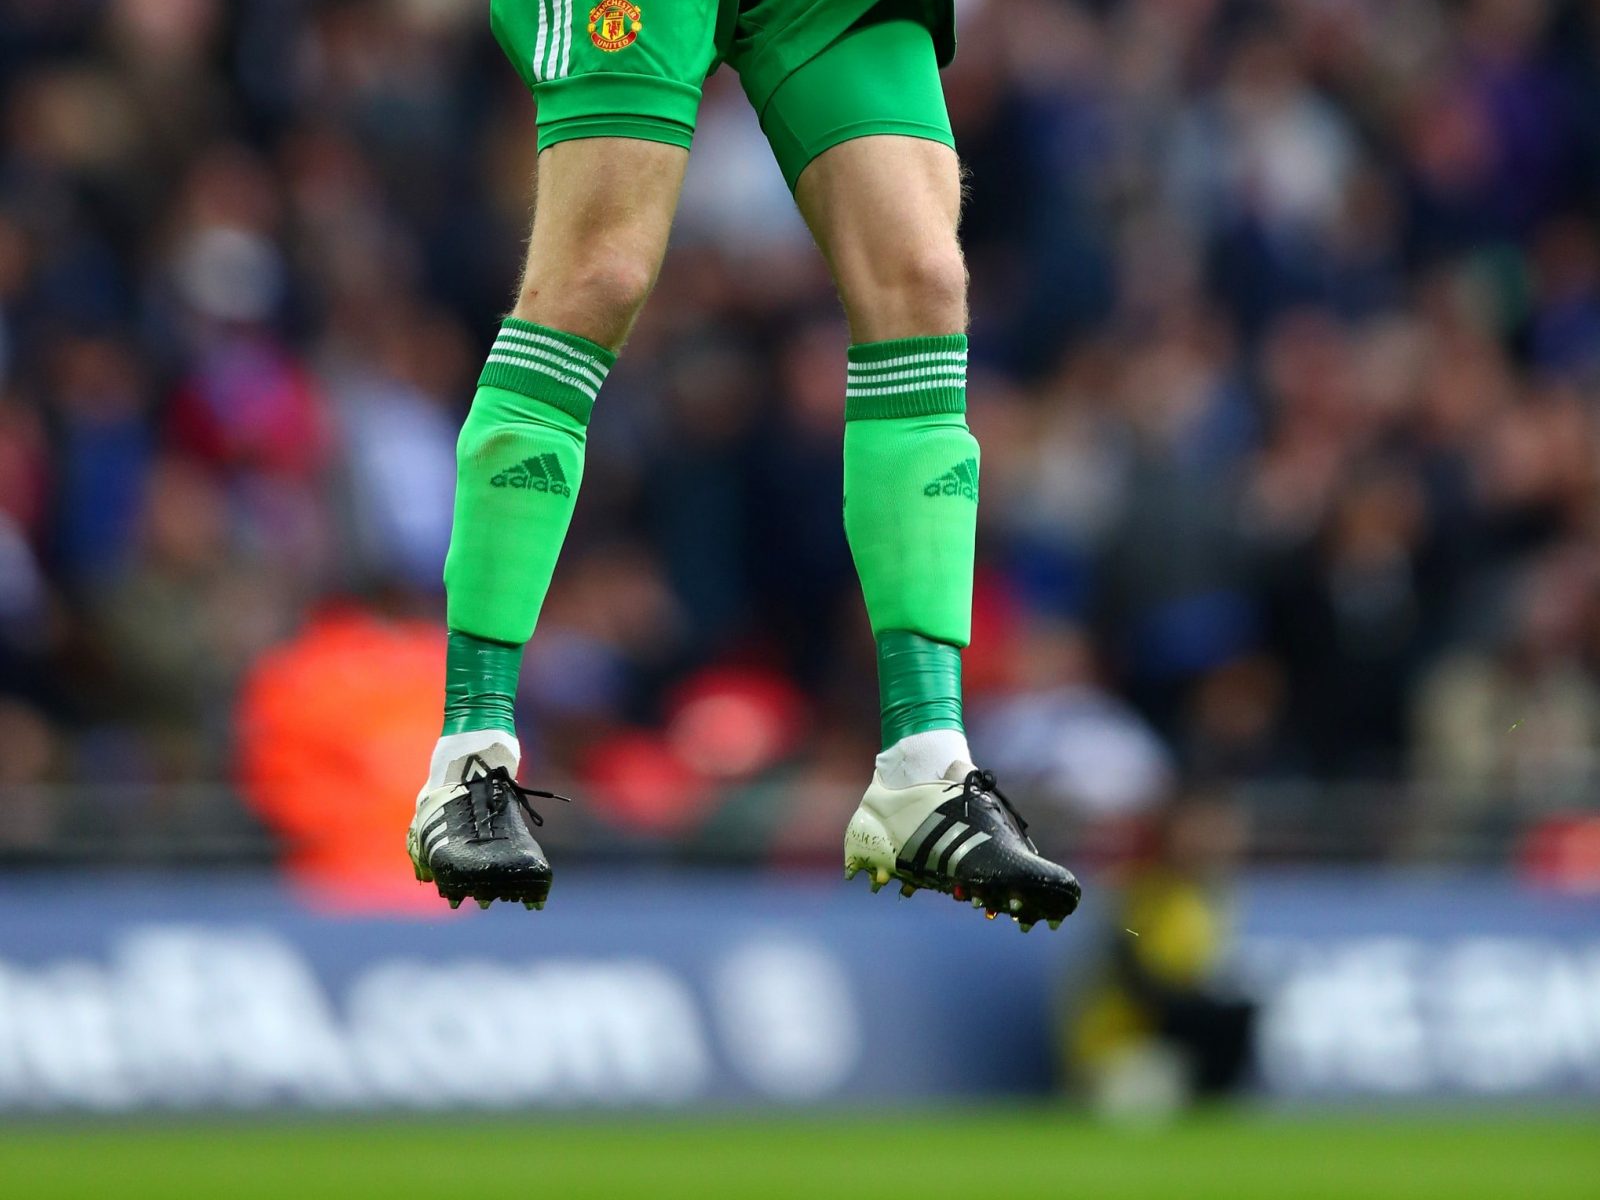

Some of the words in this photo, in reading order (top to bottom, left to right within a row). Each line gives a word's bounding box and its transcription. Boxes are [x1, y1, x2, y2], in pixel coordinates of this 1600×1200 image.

[593, 0, 637, 19] MANCHESTER
[597, 39, 629, 49] UNITED
[490, 473, 571, 498] adidas
